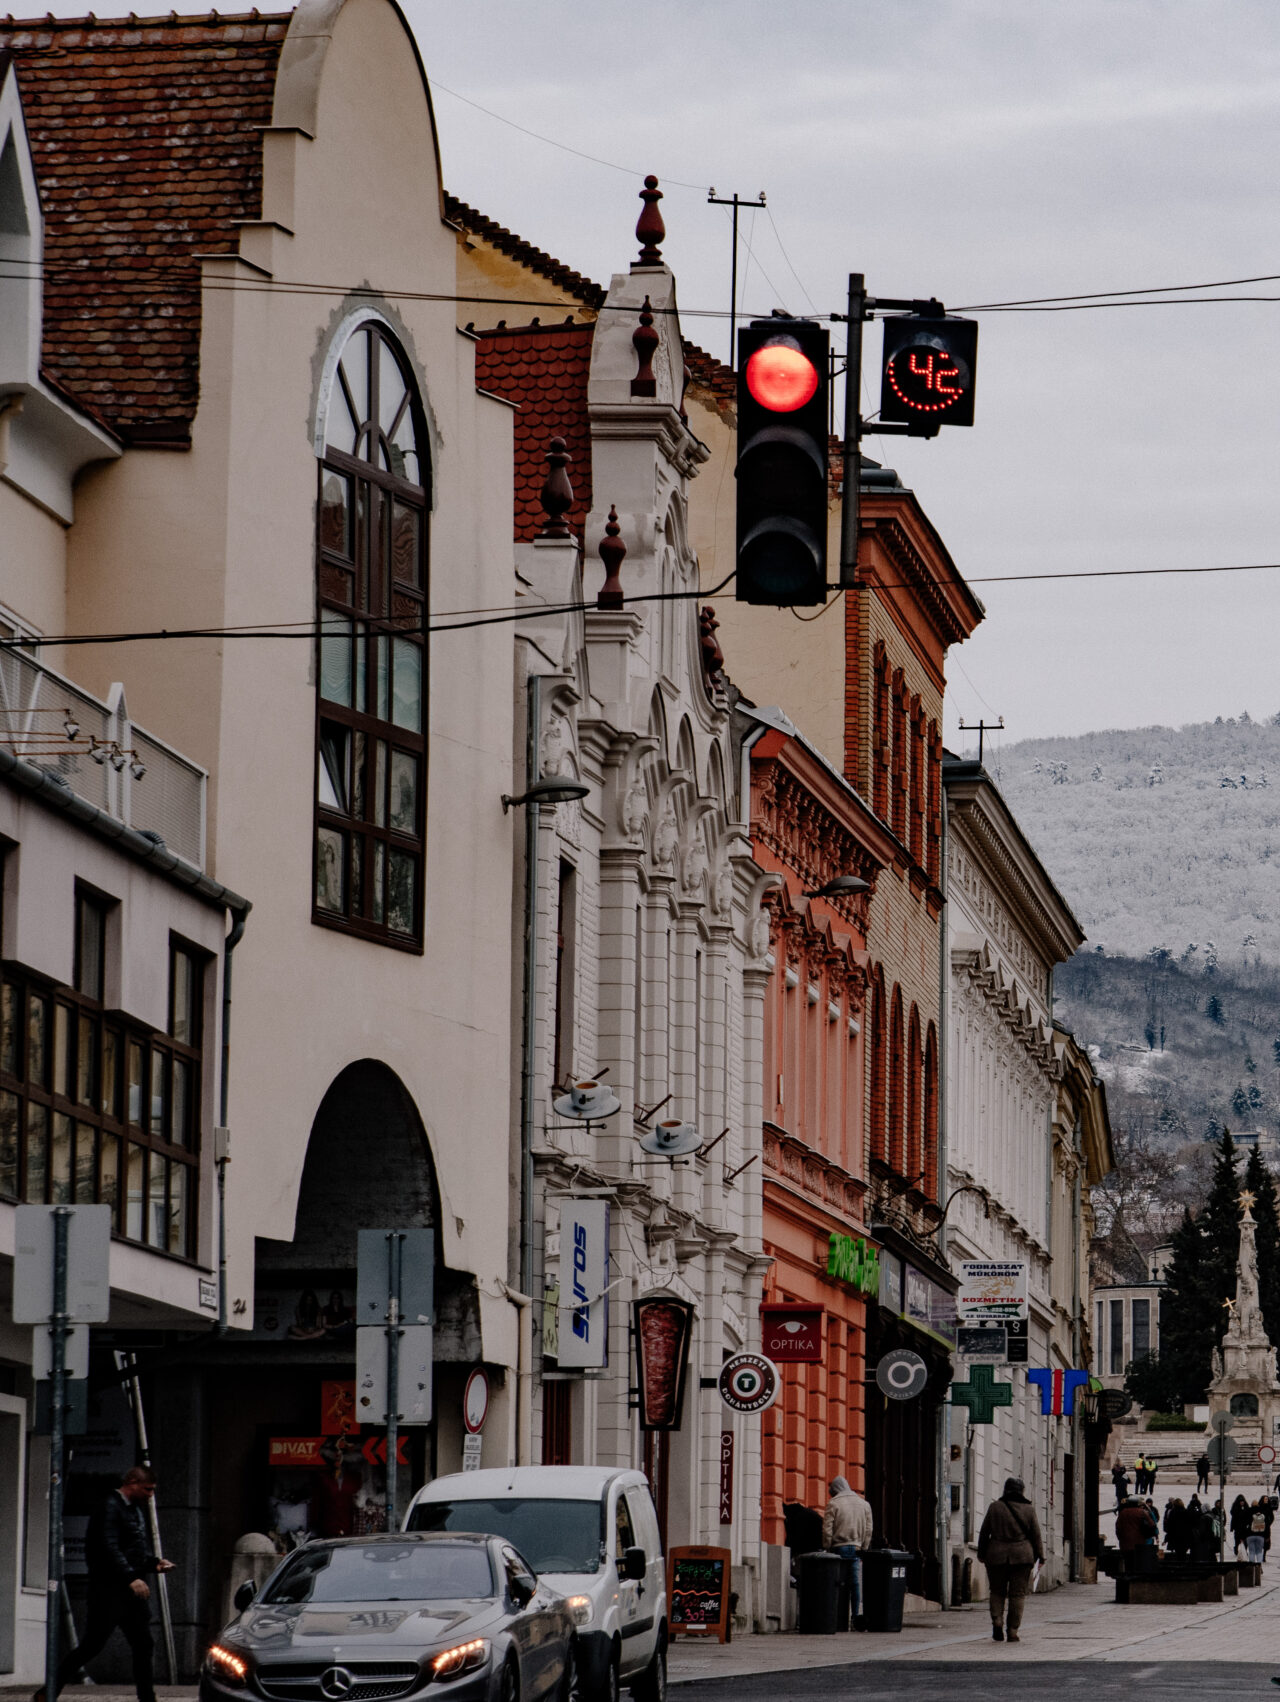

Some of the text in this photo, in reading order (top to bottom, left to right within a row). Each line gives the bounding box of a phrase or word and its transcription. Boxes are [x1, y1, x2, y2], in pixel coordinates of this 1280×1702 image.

[770, 1339, 814, 1350] OPTIKA
[728, 1355, 768, 1372] NEMZETI
[721, 1387, 773, 1409] DOHÁNYBOLT
[271, 1442, 317, 1455] DIVAT
[721, 1434, 733, 1519] OPTIKA
